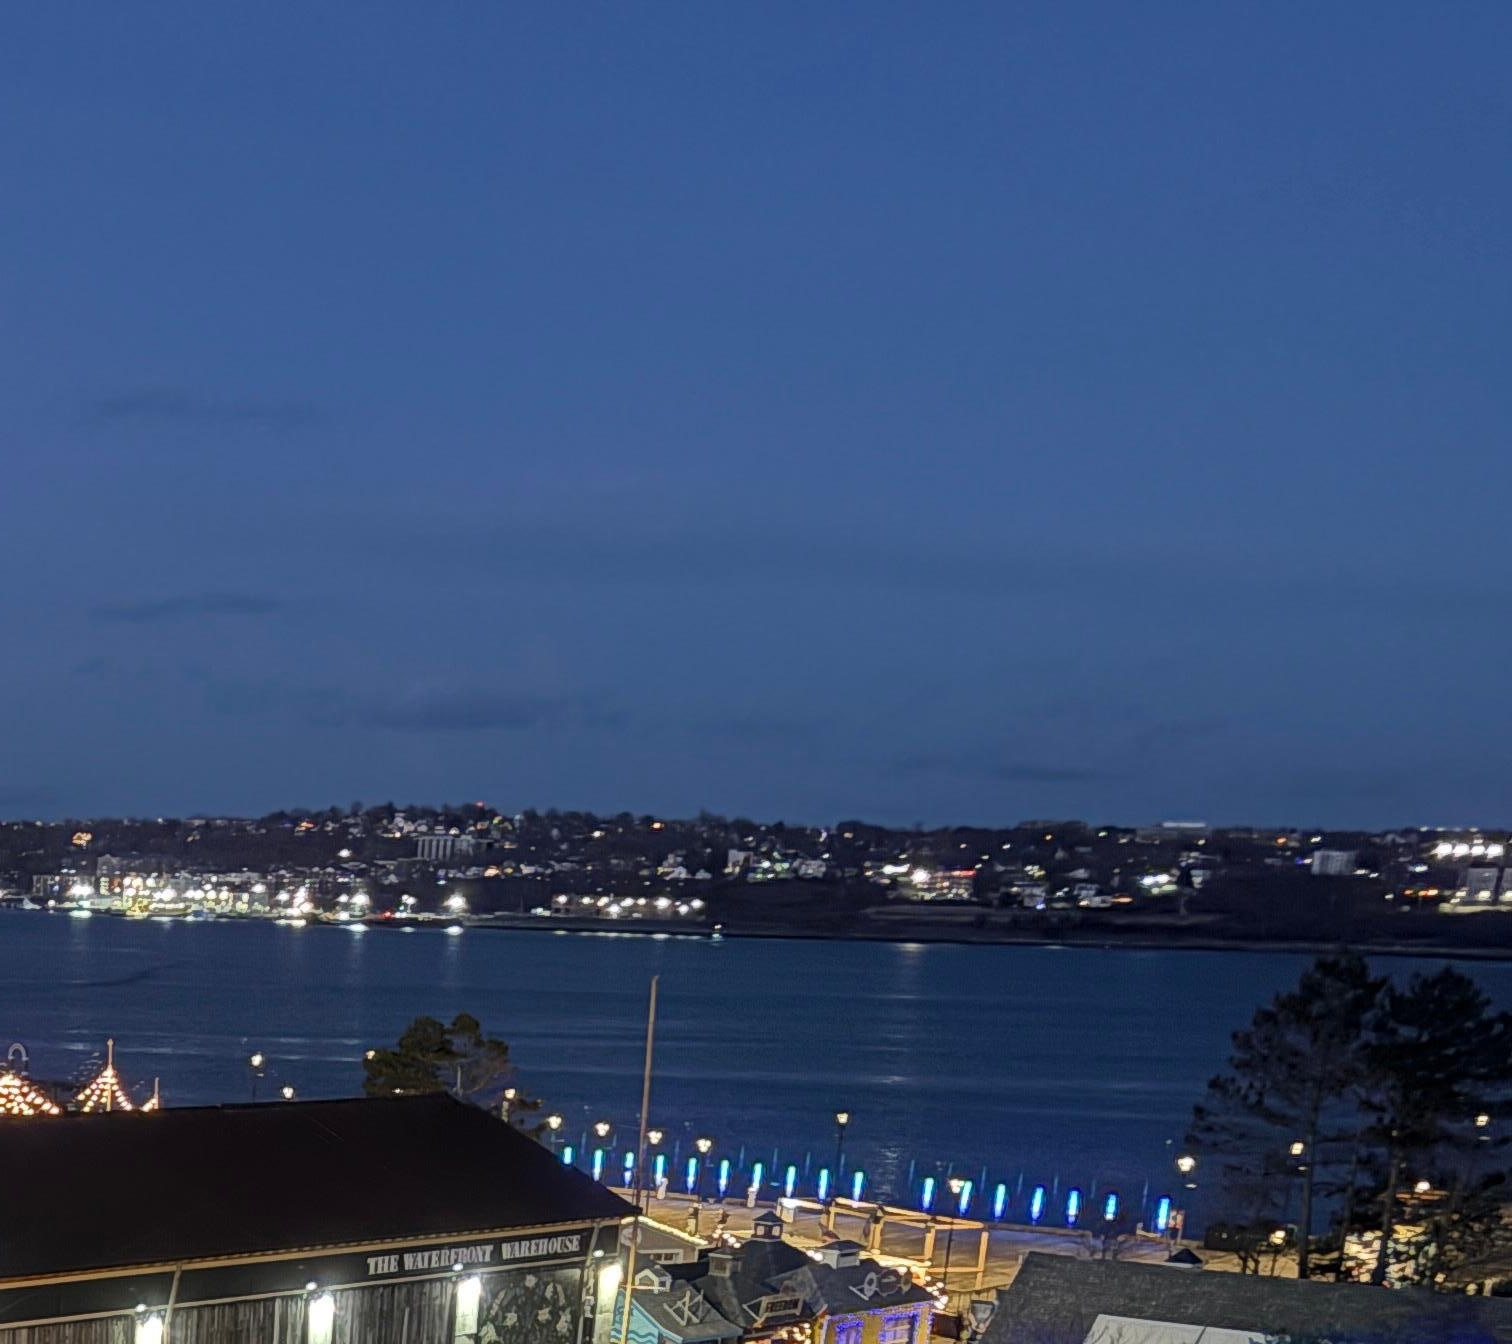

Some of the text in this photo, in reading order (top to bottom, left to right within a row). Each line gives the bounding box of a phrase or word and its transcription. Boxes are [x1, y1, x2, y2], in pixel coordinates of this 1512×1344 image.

[367, 1235, 581, 1275] THE WATERFRONT WAREHOUSE
